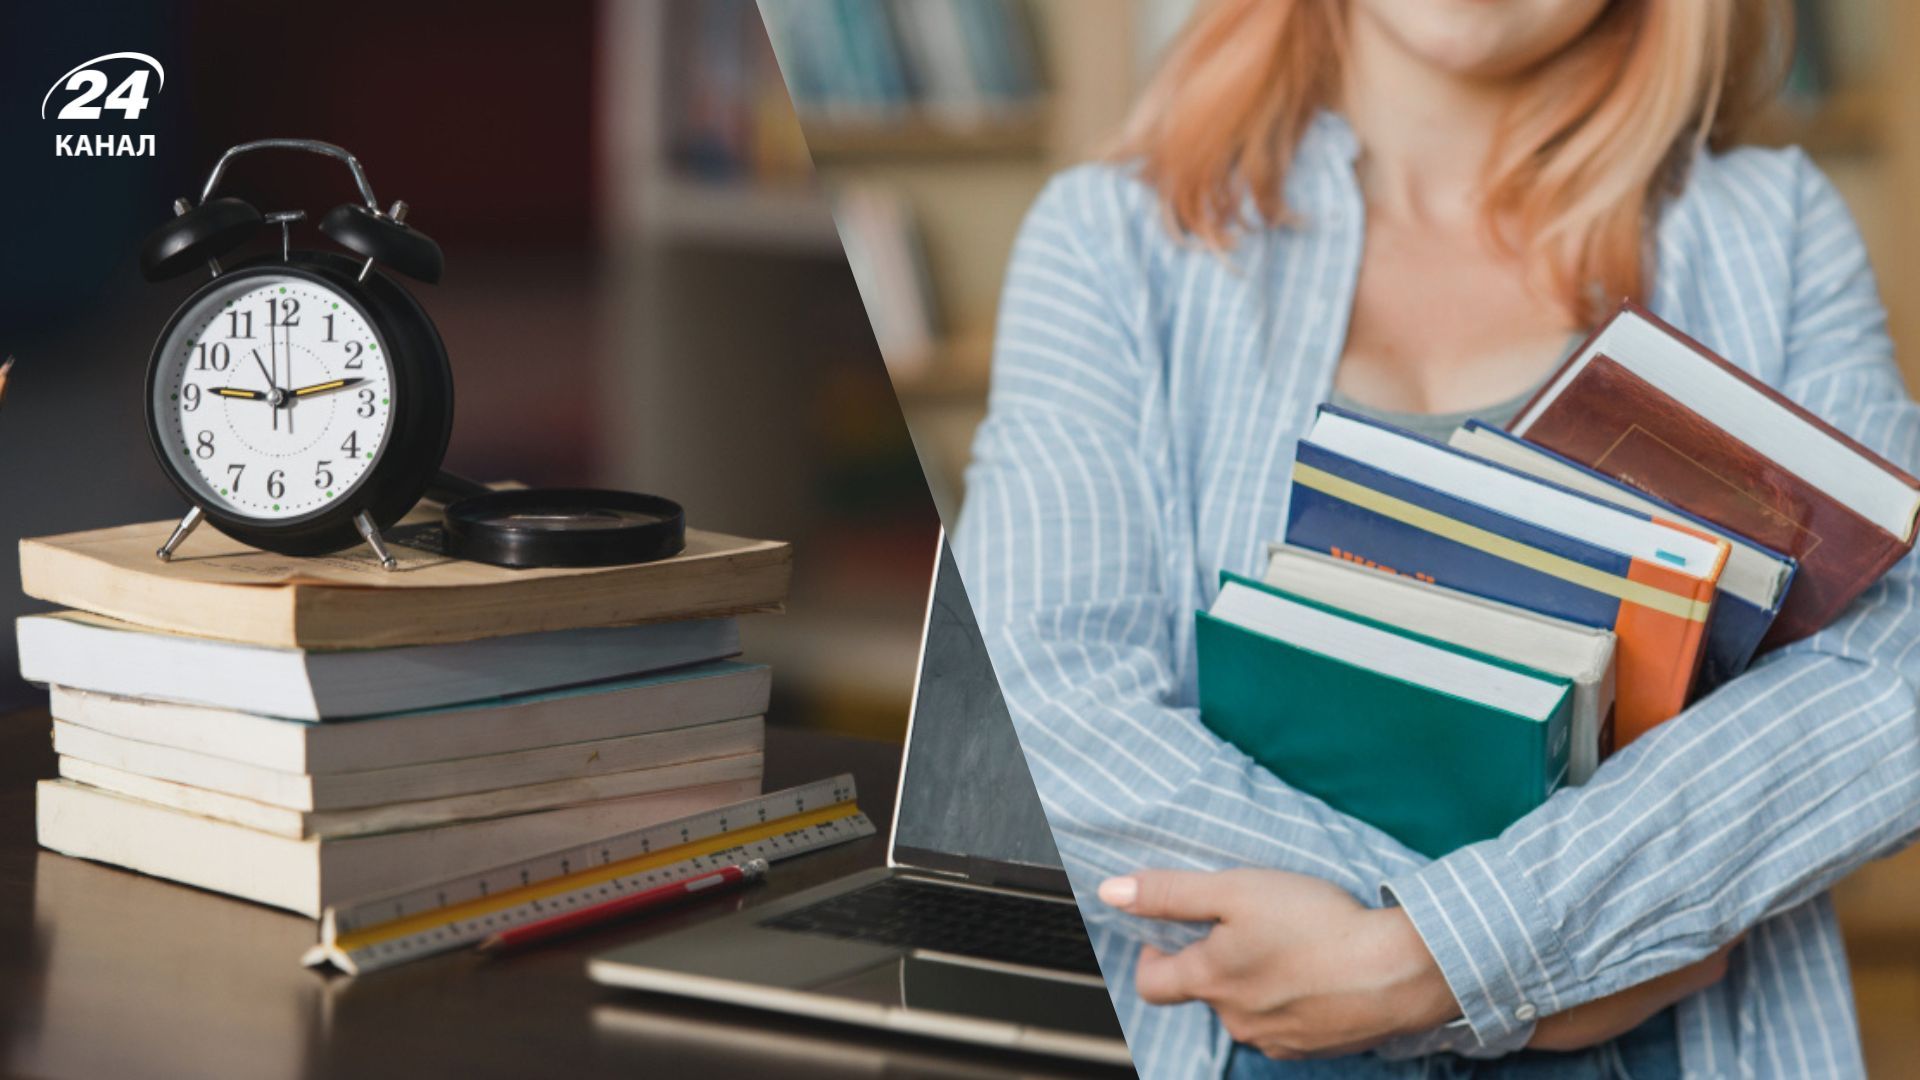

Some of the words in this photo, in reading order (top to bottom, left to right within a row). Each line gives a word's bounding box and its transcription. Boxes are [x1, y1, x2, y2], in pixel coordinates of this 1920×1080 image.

[226, 310, 257, 339] 11
[265, 297, 301, 327] 12
[322, 313, 339, 343] 1
[194, 342, 230, 371] 10
[344, 340, 364, 370] 2
[183, 383, 200, 412] 9
[357, 389, 376, 418] 3
[196, 430, 215, 459] 8
[340, 430, 361, 459] 4
[227, 464, 247, 493] 7
[267, 470, 285, 499] 6
[314, 460, 334, 489] 5
